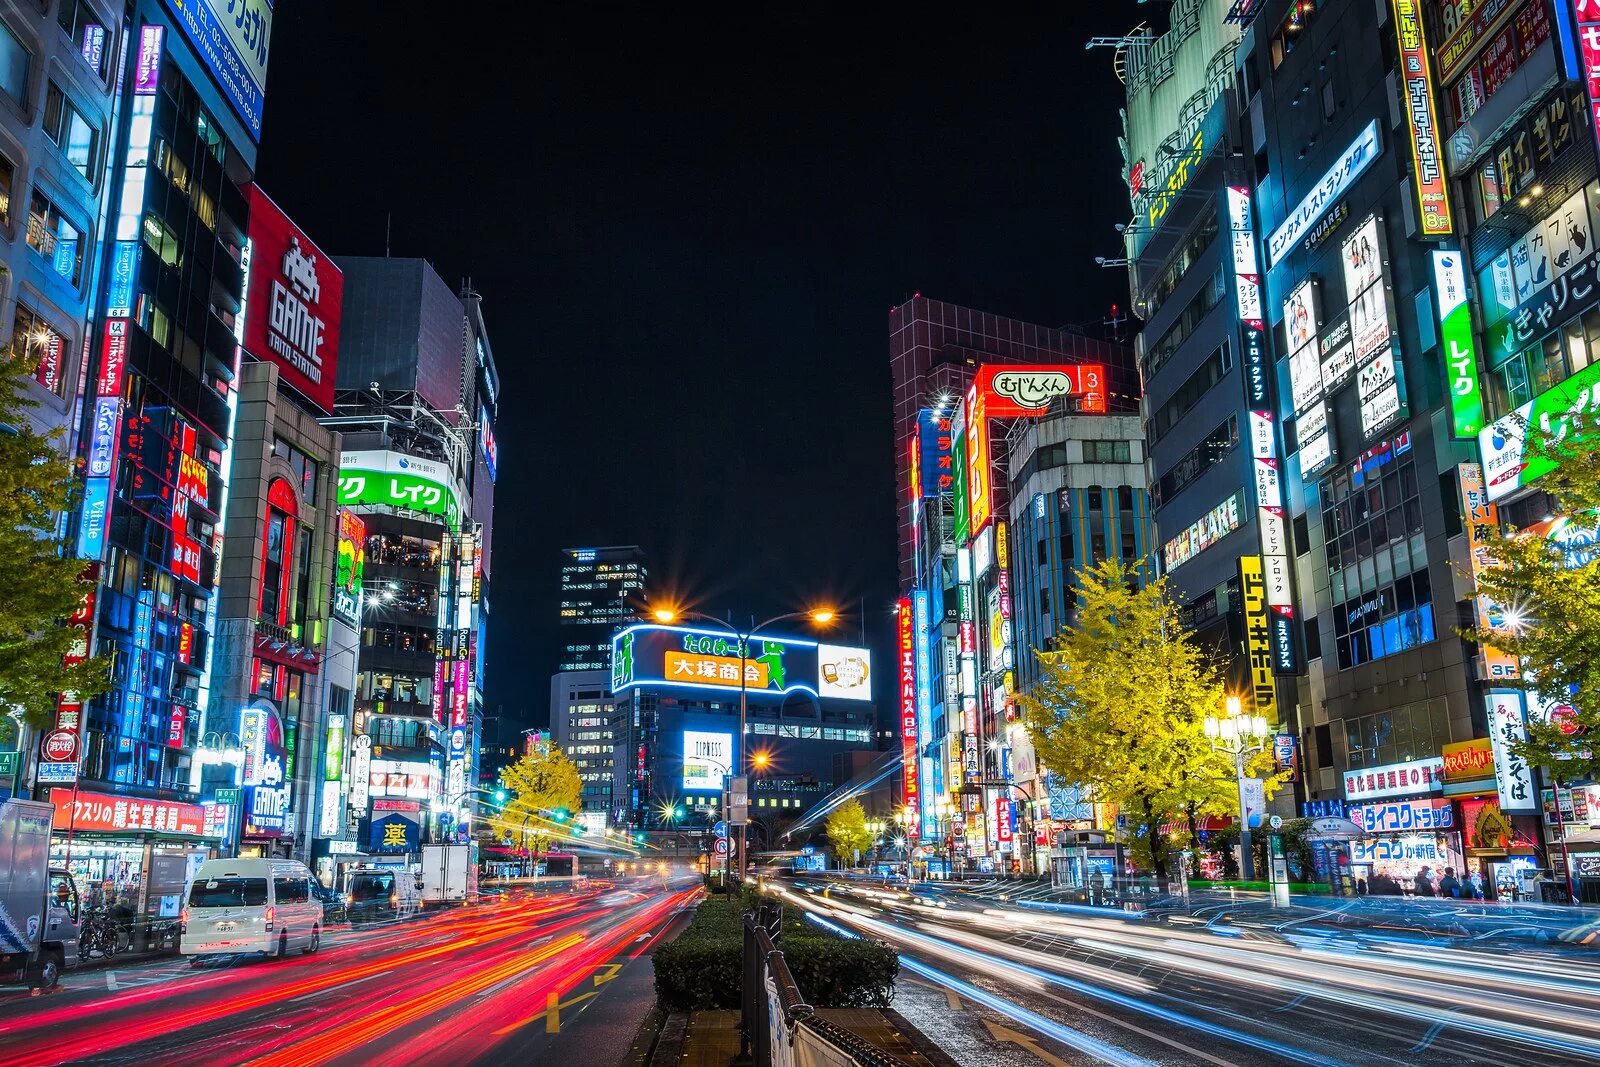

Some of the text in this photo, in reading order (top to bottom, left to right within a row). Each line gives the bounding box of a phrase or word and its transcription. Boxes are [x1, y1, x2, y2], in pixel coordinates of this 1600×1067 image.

[1442, 24, 1475, 70] まんが
[1408, 78, 1439, 184] インターネット
[1272, 137, 1374, 258] エンタメレストランタワー
[1304, 206, 1341, 251] SQUARE
[1424, 212, 1449, 230] 8F
[1513, 210, 1574, 268] 猫カフェ
[112, 309, 125, 317] 6F
[1514, 263, 1593, 342] きゃりこ
[271, 280, 325, 366] GAME
[1355, 325, 1389, 361] Carnival
[106, 335, 120, 394] ユニオンアセット
[1247, 330, 1264, 401] ザ・ロックアップ
[1450, 340, 1473, 396] レイク
[1000, 376, 1065, 404] むじんくん
[410, 461, 436, 475] 新生銀行
[938, 418, 953, 489] カラオケ
[1488, 446, 1518, 471] 新生銀行
[338, 477, 366, 499] ク
[1496, 464, 1523, 485] カードローン
[389, 478, 441, 505] レイク
[1466, 489, 1481, 521] セット
[87, 499, 104, 539] Vitule
[684, 634, 751, 658] たのめーる
[1244, 573, 1275, 708] ドン・キホーテ
[1278, 620, 1291, 668] ミステリアス
[673, 658, 761, 682] 大塚商会
[1491, 664, 1515, 677] 3F
[49, 740, 73, 752] 消火栓
[1444, 747, 1486, 772] ARABIAN
[72, 799, 179, 831] クスリの龍生堂薬局
[253, 788, 286, 816] GAME
[1365, 803, 1453, 831] ダイコクドラッグ
[383, 822, 407, 847] 薬
[999, 800, 1012, 839] パチスロ
